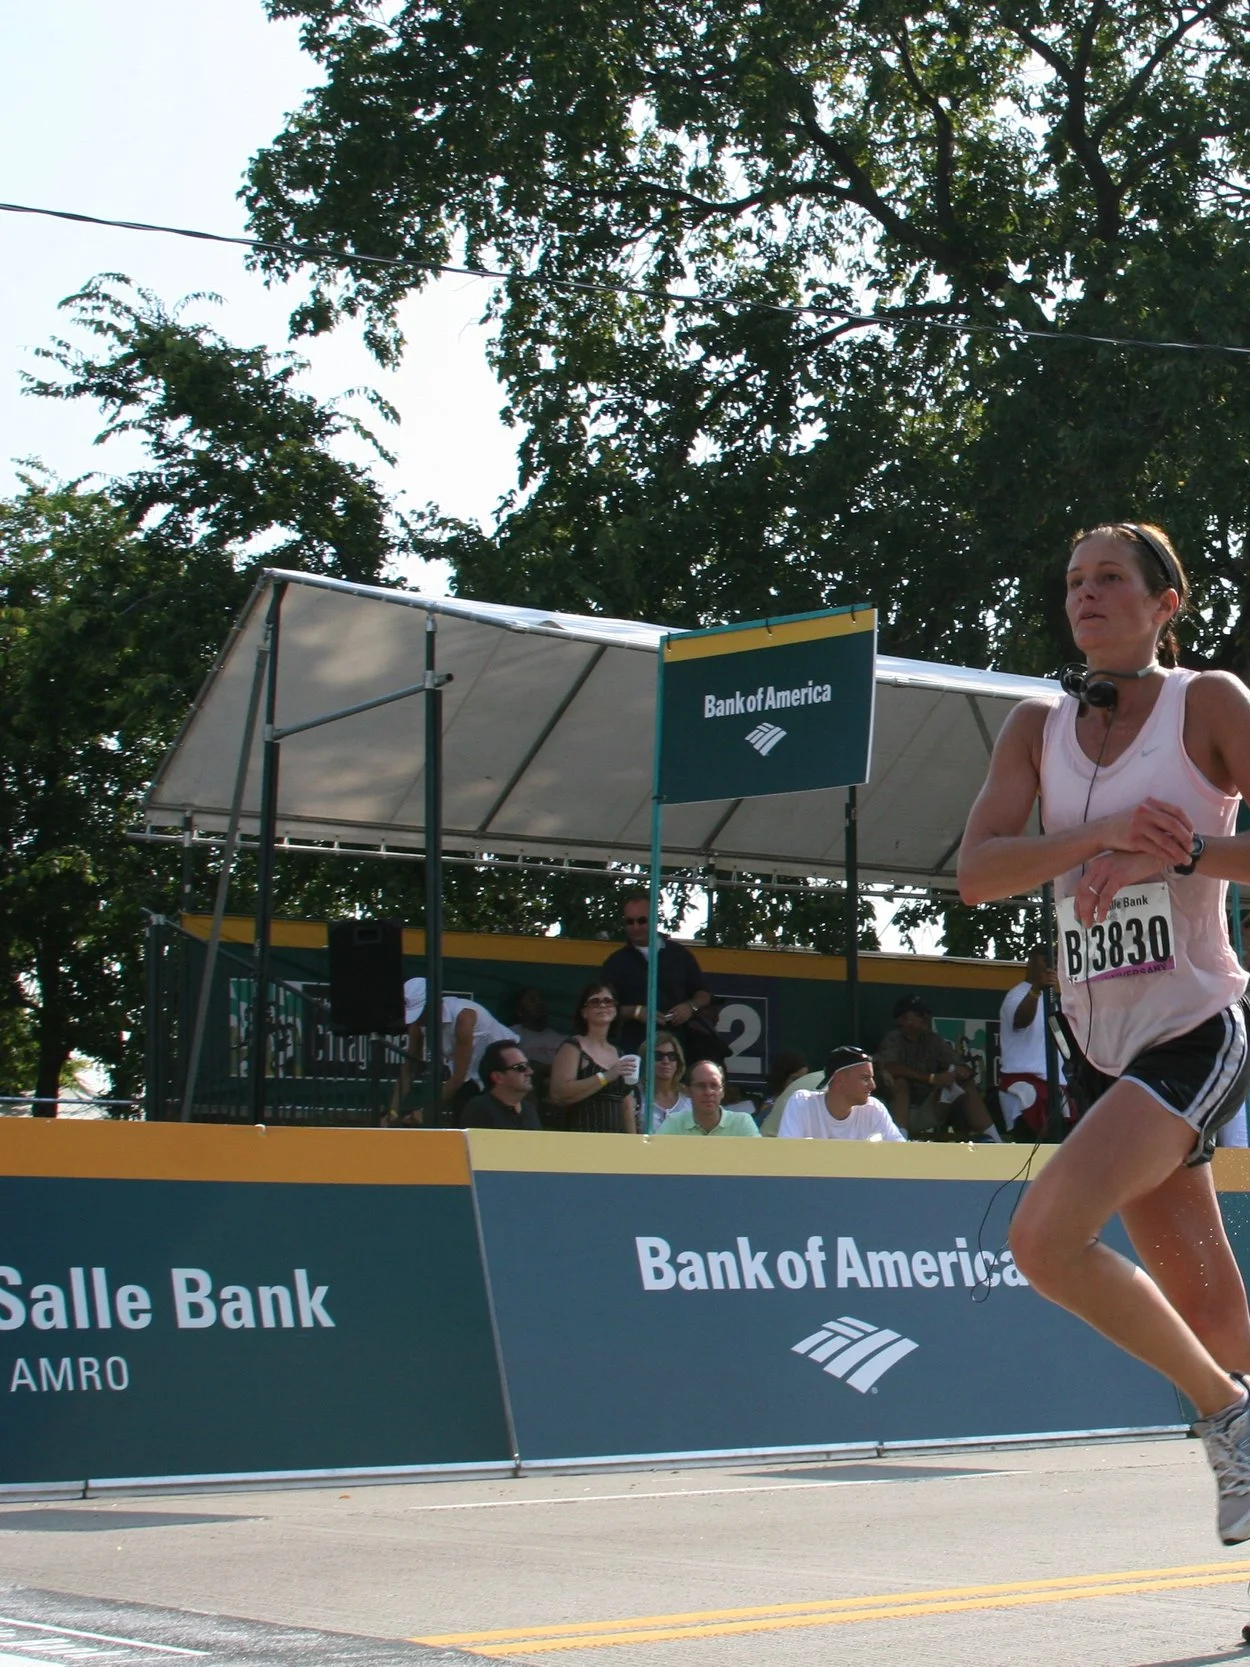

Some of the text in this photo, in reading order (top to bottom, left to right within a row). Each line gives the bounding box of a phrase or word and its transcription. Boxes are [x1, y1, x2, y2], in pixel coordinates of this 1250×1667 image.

[704, 680, 832, 718] Bank of America
[1123, 894, 1149, 909] Bank
[635, 1235, 1030, 1291] Bank of America
[0, 1265, 336, 1331] Salle Bank
[10, 1355, 130, 1393] AMRO
